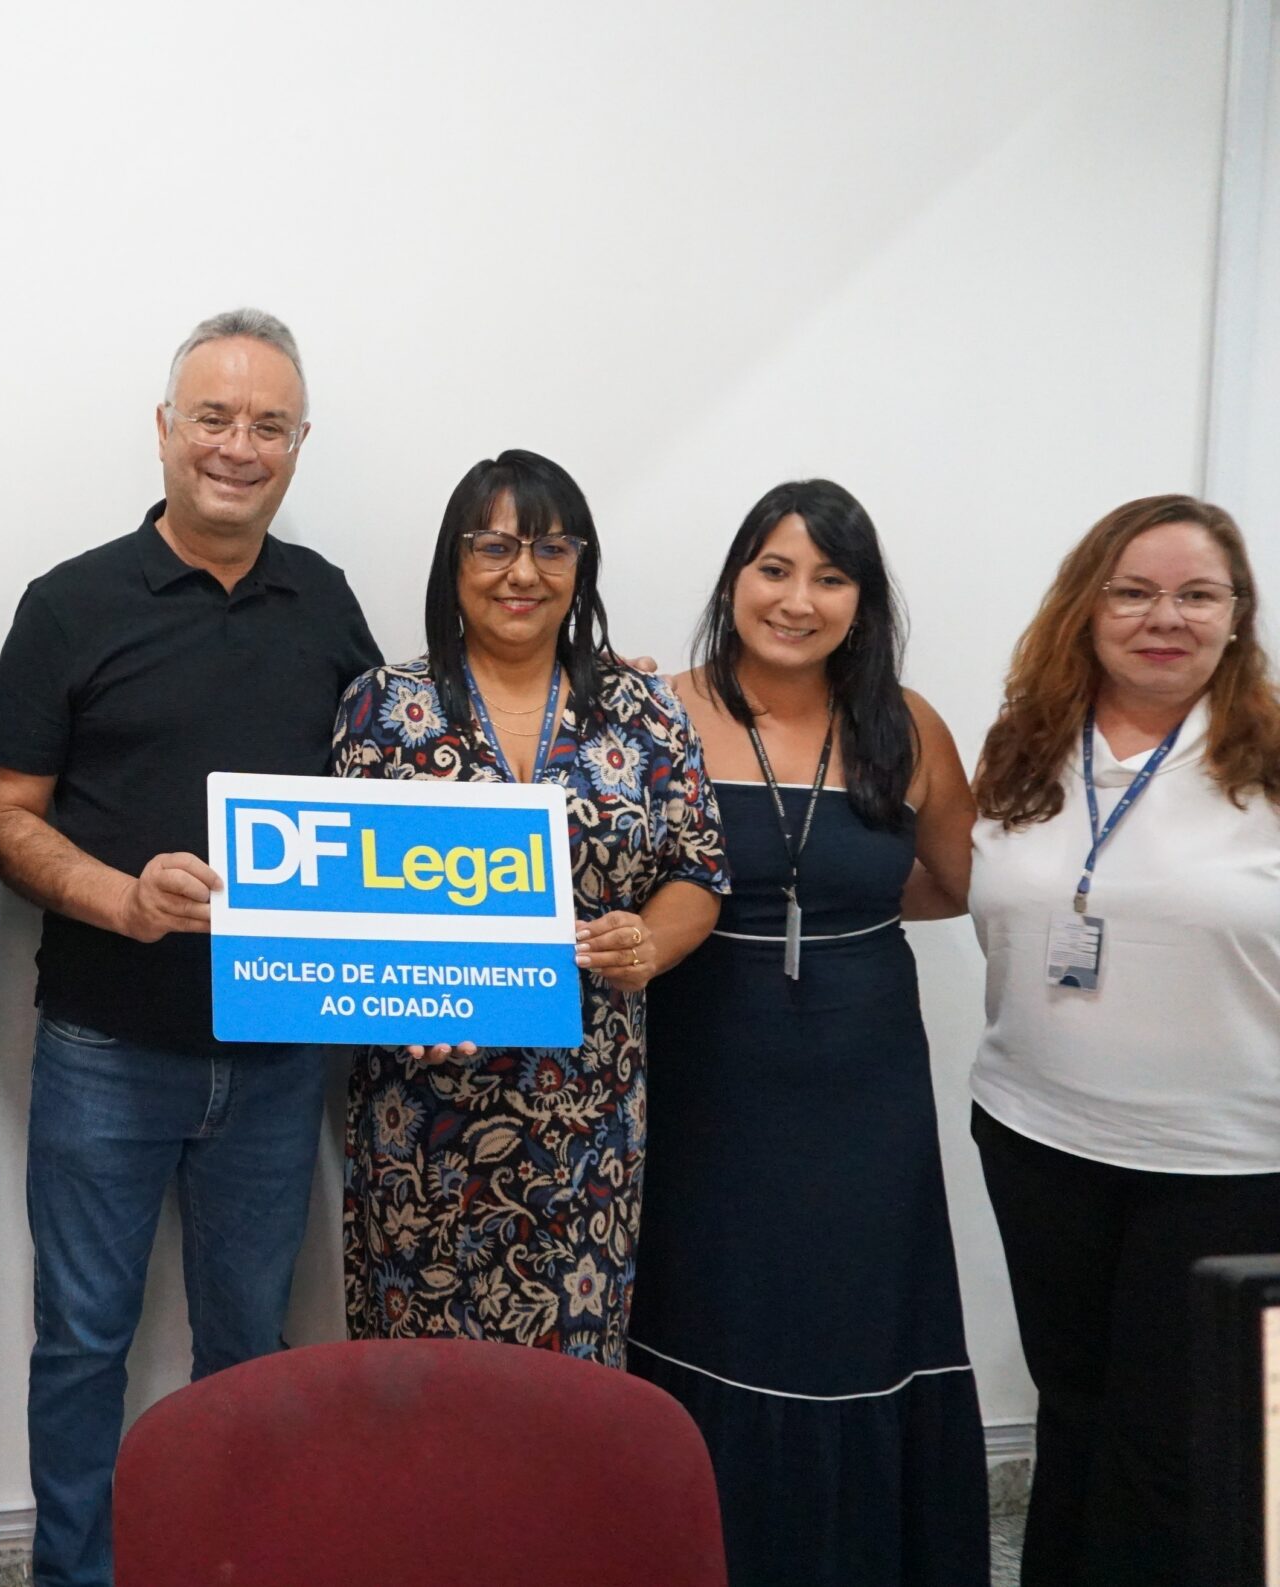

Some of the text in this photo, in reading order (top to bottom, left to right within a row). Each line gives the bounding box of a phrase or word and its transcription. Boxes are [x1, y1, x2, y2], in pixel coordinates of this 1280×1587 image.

[234, 807, 546, 906] DF Legal
[233, 956, 557, 988] NÚCLEO DE ATENDIMENTO
[320, 993, 474, 1019] AO CIDADÃO
